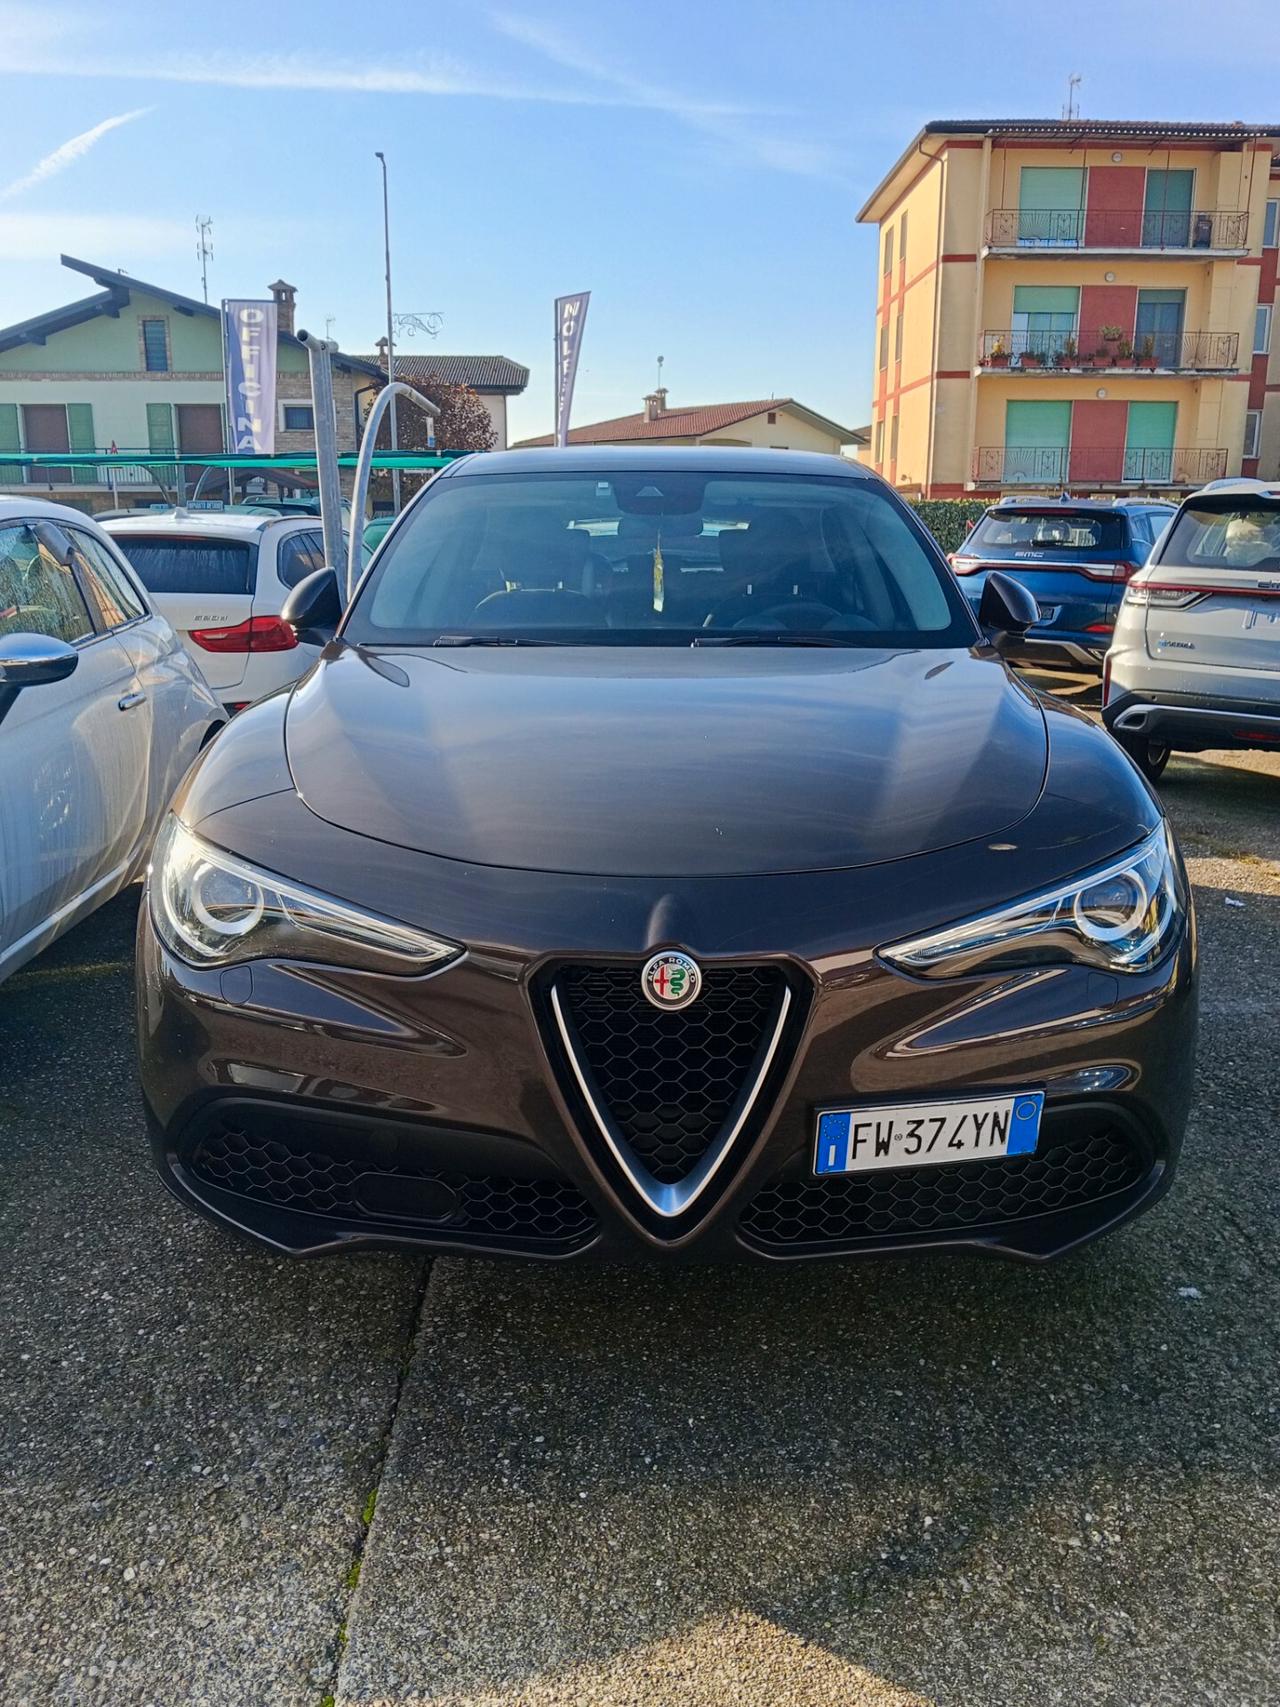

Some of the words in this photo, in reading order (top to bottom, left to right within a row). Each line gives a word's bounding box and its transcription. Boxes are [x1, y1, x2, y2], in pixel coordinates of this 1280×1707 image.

[238, 308, 264, 450] OFFICINA
[647, 960, 665, 982] ALFA
[668, 957, 696, 983] ROMEO
[851, 1120, 894, 1160] FW
[903, 1109, 1011, 1155] 374YN
